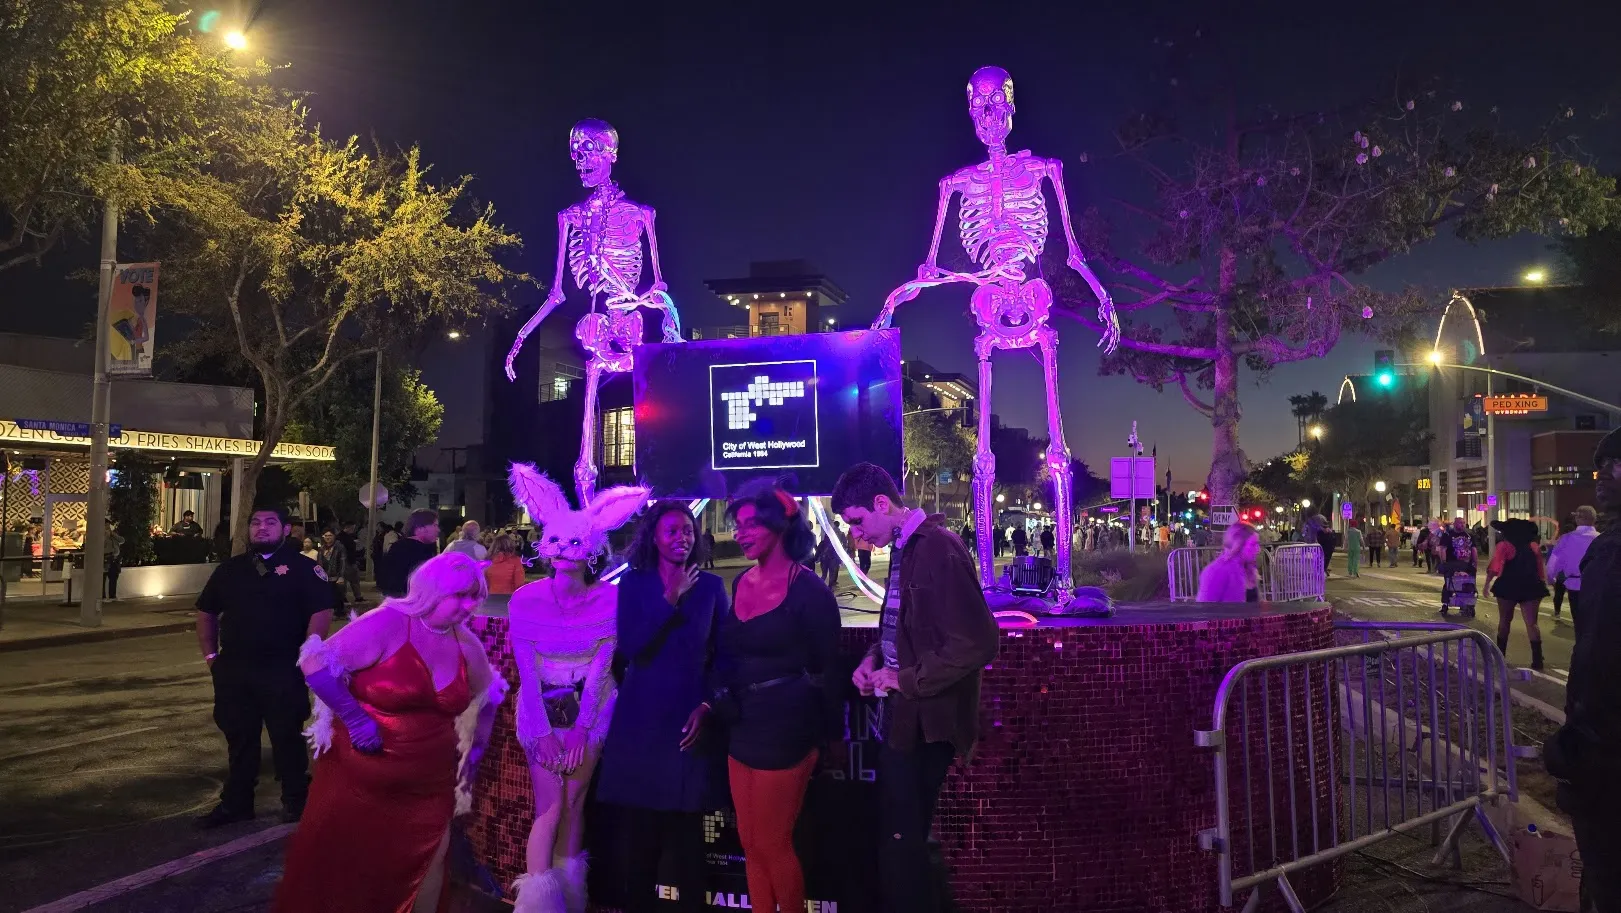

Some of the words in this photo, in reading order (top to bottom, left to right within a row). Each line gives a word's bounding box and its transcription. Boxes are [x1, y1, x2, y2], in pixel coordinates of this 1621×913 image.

[121, 267, 154, 284] VOTE
[1515, 400, 1538, 408] XING
[24, 420, 47, 430] SANTA
[49, 421, 76, 432] MONICA
[138, 434, 179, 449] FRIES
[185, 436, 239, 453] SHAKES
[245, 441, 301, 457] BUGERS
[722, 442, 738, 452] City
[738, 441, 747, 450] of
[747, 441, 767, 450] West
[768, 440, 806, 450] Hollywood
[728, 854, 747, 862] Hollyw
[705, 891, 838, 913] ALLEN
